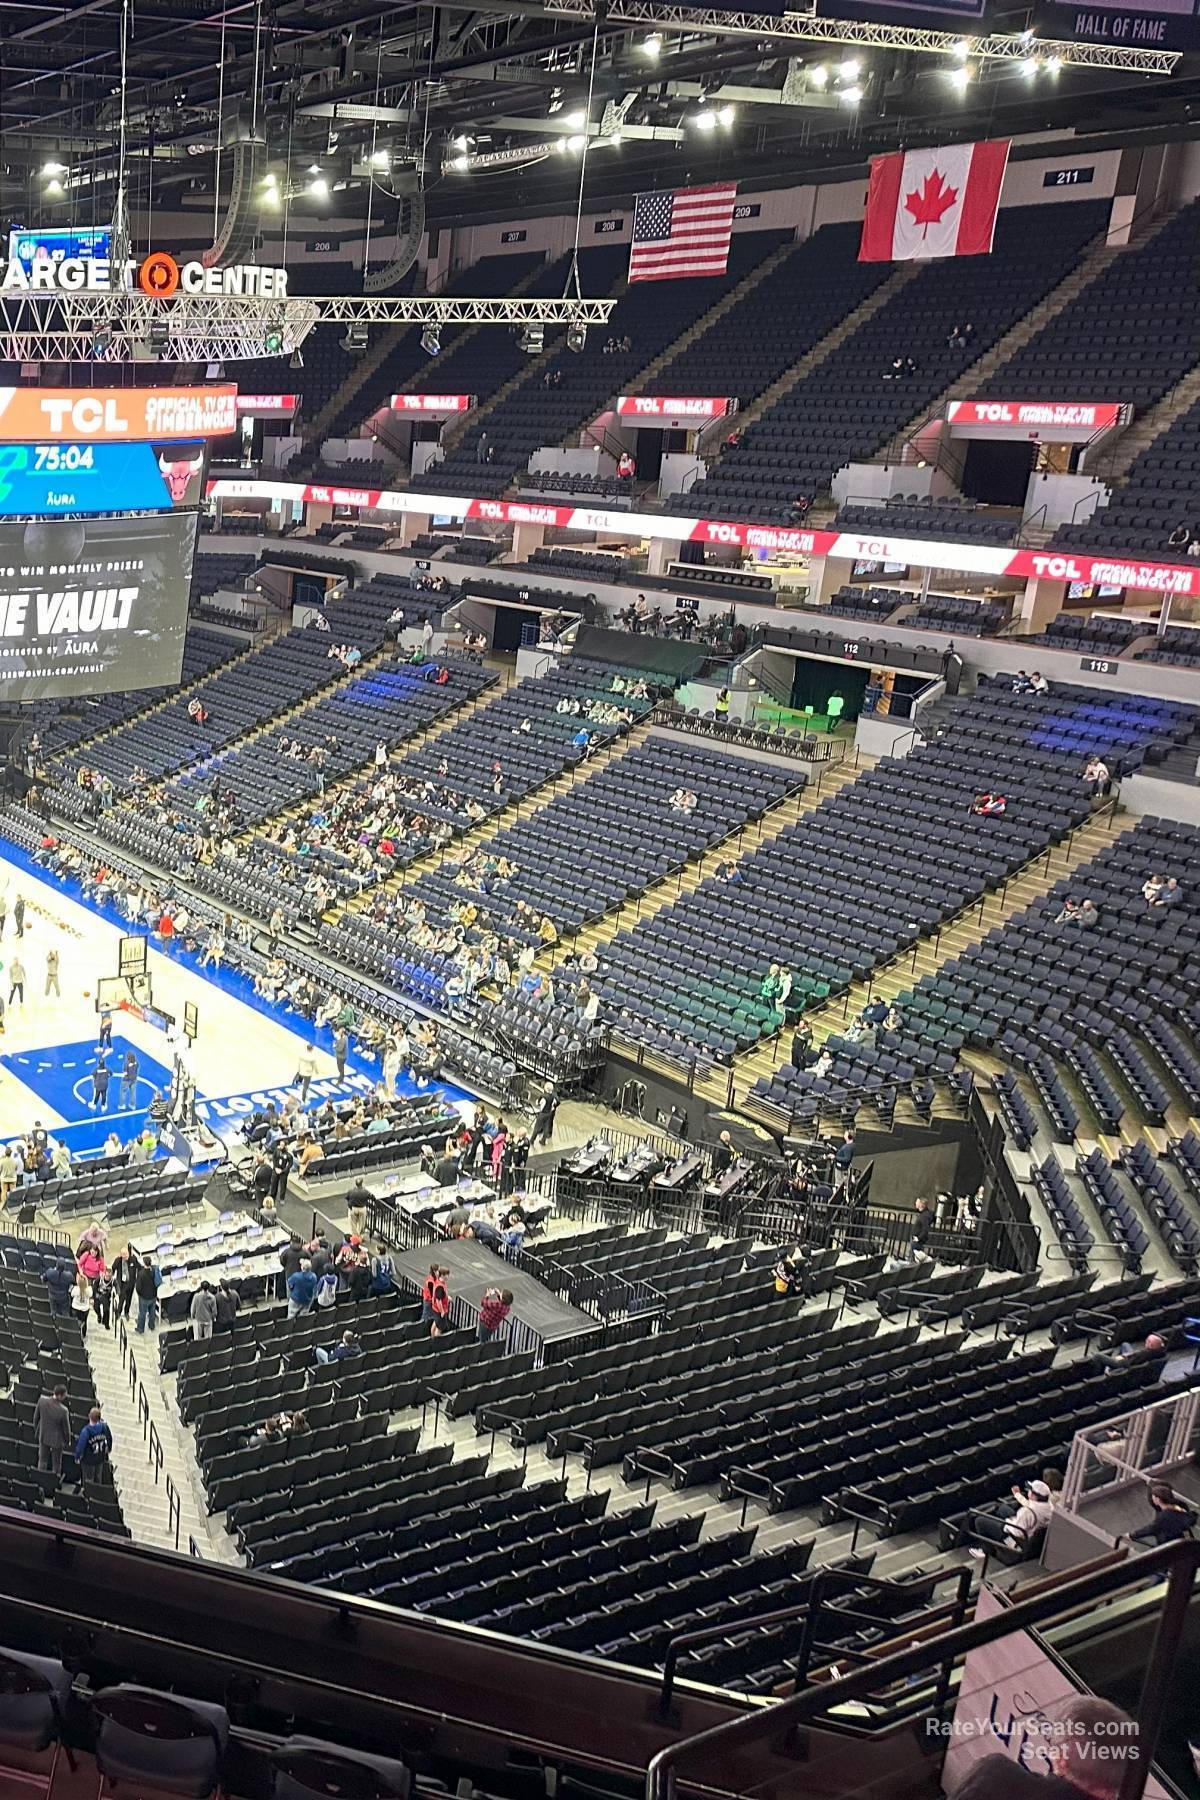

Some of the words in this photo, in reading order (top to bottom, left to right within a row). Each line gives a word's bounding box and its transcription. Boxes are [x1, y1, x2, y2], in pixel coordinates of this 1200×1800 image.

[1075, 13, 1109, 36] HALL
[1112, 17, 1131, 38] OF
[1132, 19, 1168, 41] FAME
[1056, 170, 1079, 185] 211
[735, 206, 752, 218] 209
[508, 232, 521, 242] 207
[181, 260, 288, 298] CENTER
[635, 399, 660, 413] TCL
[975, 404, 1012, 421] TCL
[41, 398, 128, 433] TCL
[34, 446, 94, 471] 75:04
[480, 503, 503, 519] TCL
[707, 524, 741, 543] TCL
[856, 541, 892, 556] TCL
[0, 566, 15, 577] TO
[20, 565, 44, 576] WIN
[50, 563, 102, 576] MONTHLY
[106, 560, 144, 572] PRIZES
[1032, 556, 1081, 579] TCL
[36, 587, 139, 635] VAULT
[843, 643, 859, 654] 112
[1090, 660, 1109, 673] 113
